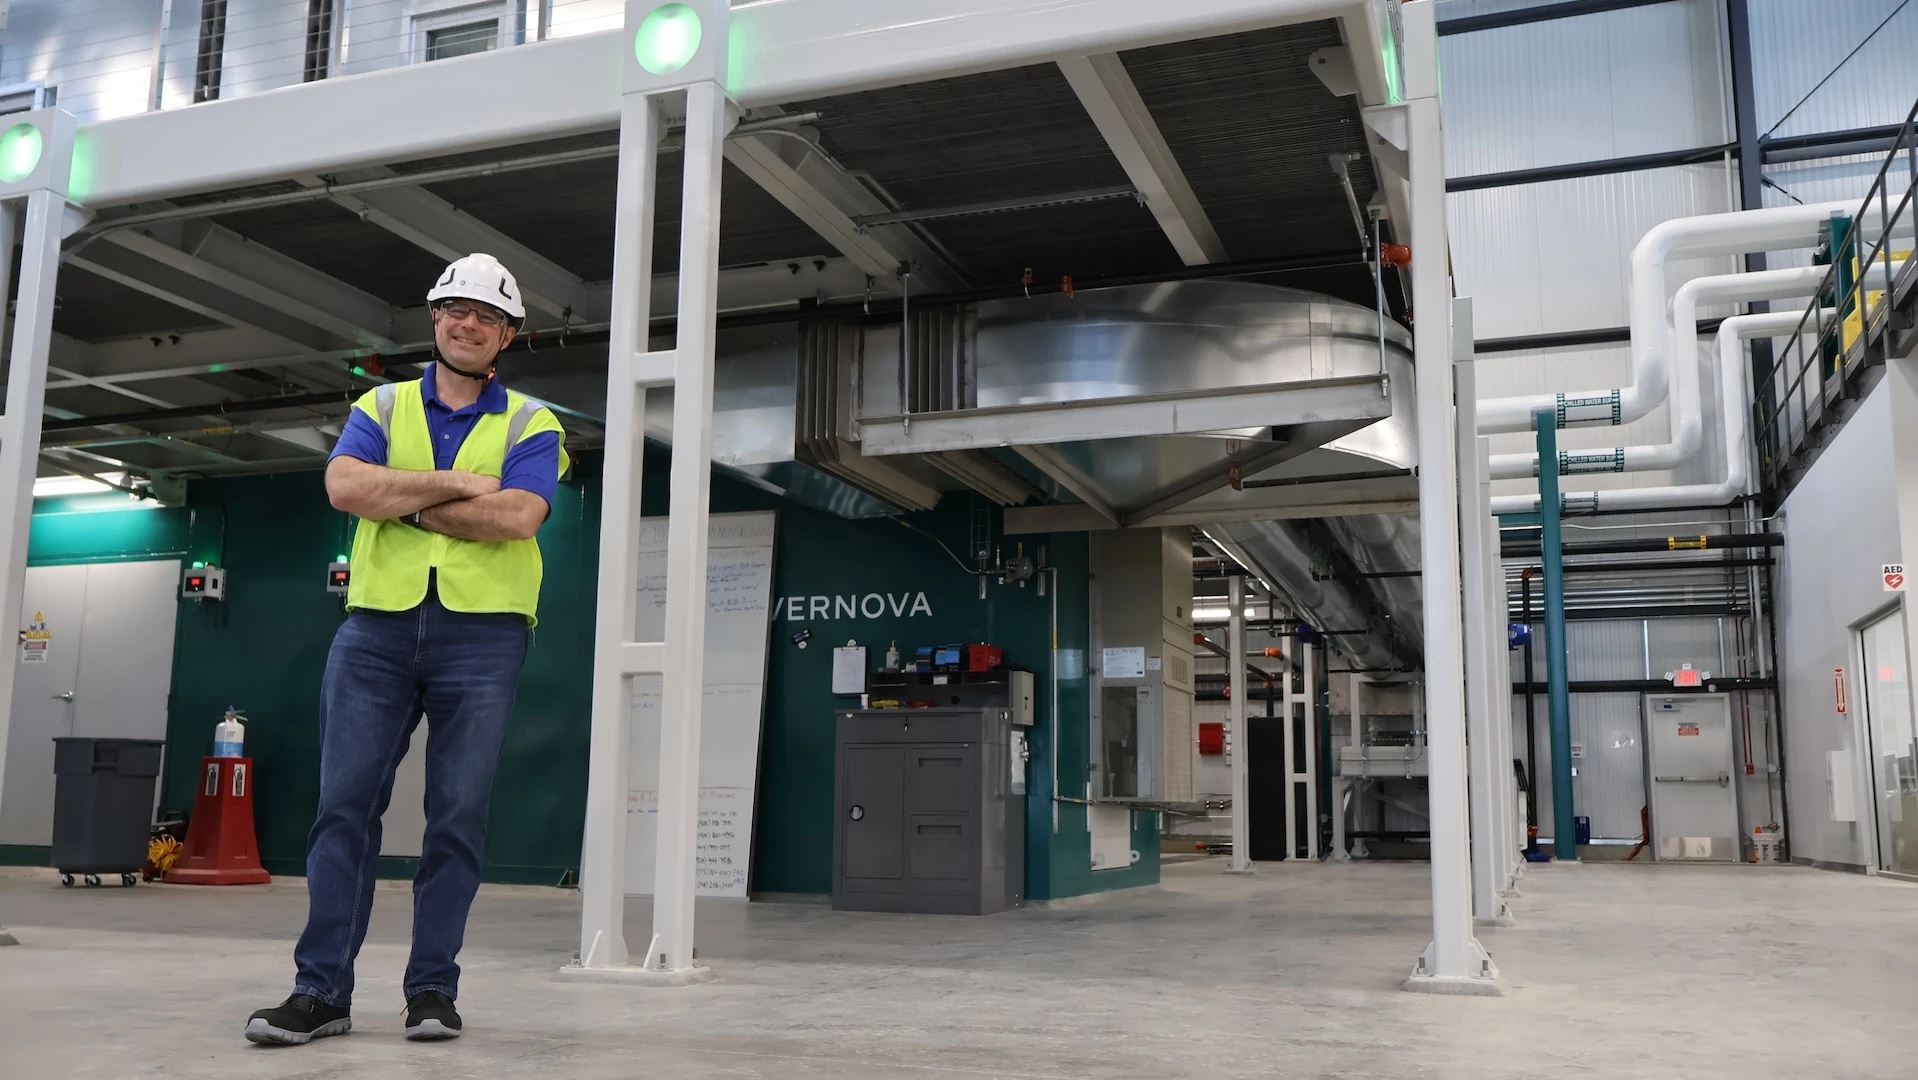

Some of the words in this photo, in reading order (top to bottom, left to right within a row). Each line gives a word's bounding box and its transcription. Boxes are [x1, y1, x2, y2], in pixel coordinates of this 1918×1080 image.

[1564, 399, 1584, 407] CHILLED
[1585, 398, 1601, 406] WATER
[1884, 565, 1903, 574] AED
